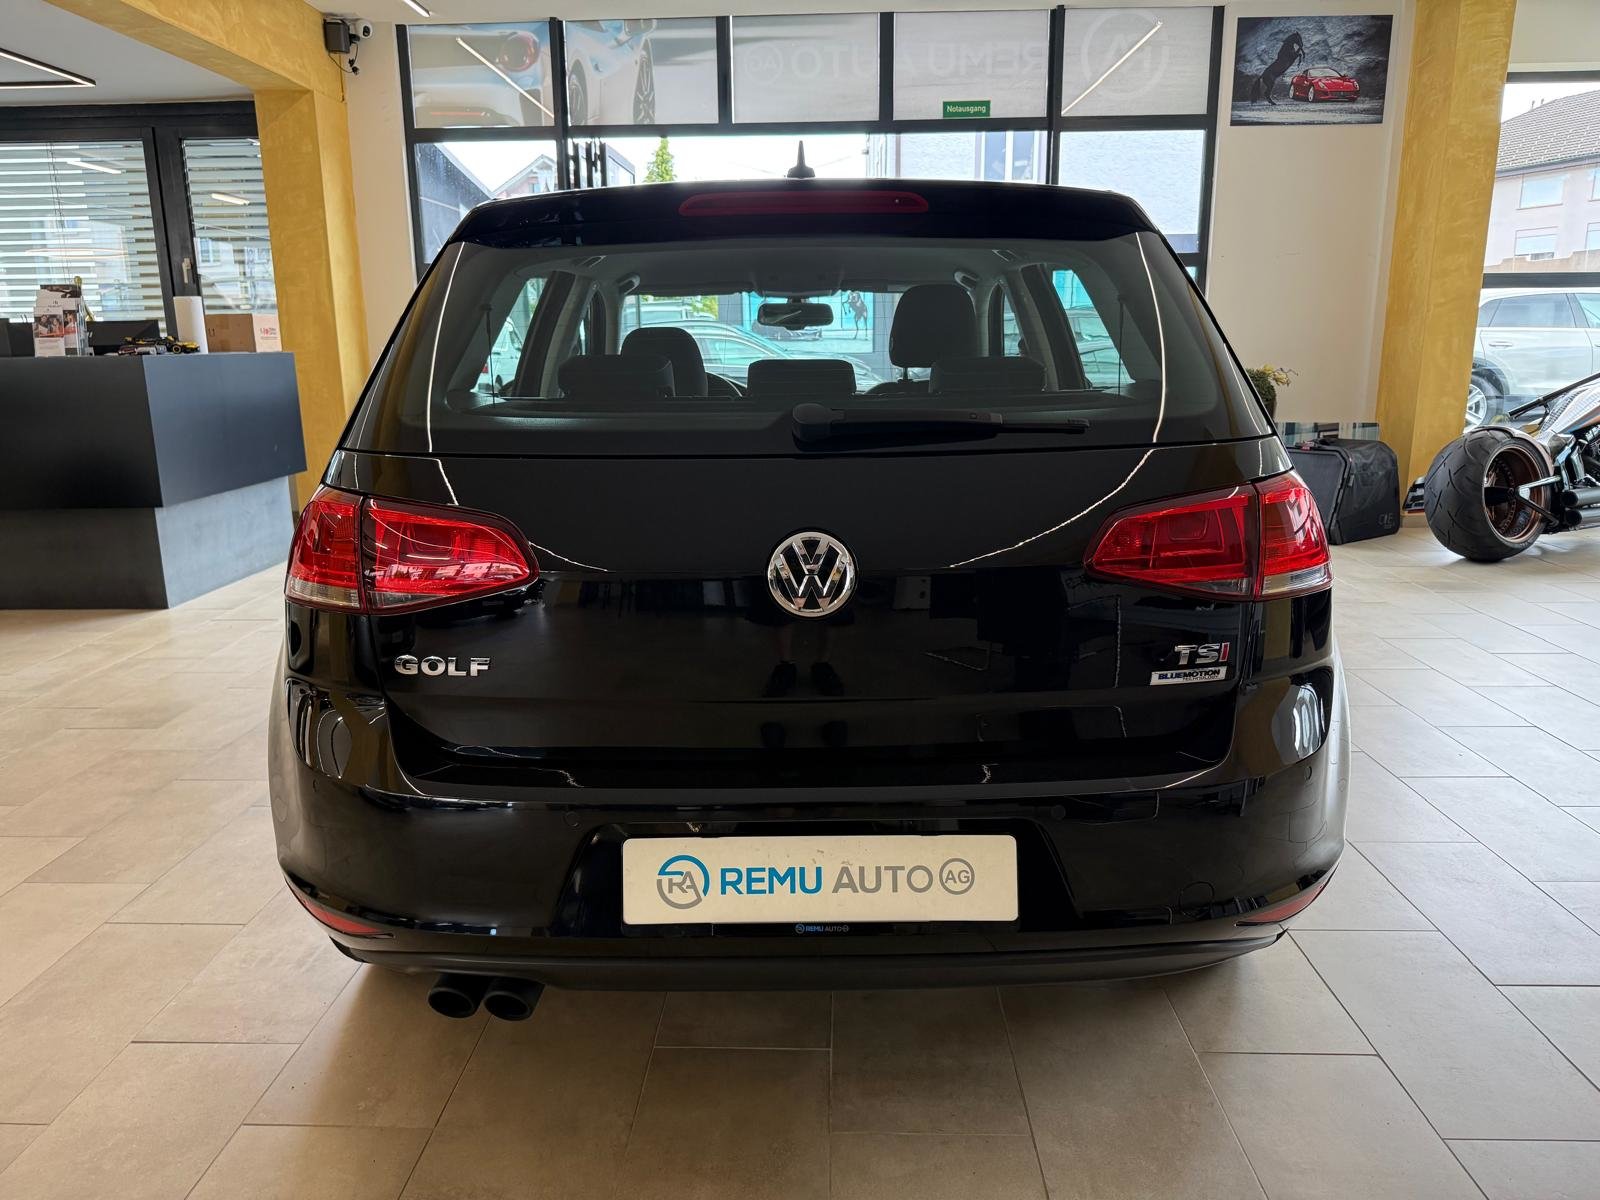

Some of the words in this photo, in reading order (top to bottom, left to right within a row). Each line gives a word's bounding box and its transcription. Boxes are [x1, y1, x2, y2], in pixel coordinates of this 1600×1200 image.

[946, 105, 987, 114] Notausgang
[394, 654, 491, 677] GOLF
[1158, 668, 1221, 680] BLUEMOTION
[720, 866, 823, 895] REMU
[831, 865, 934, 893] AUTO
